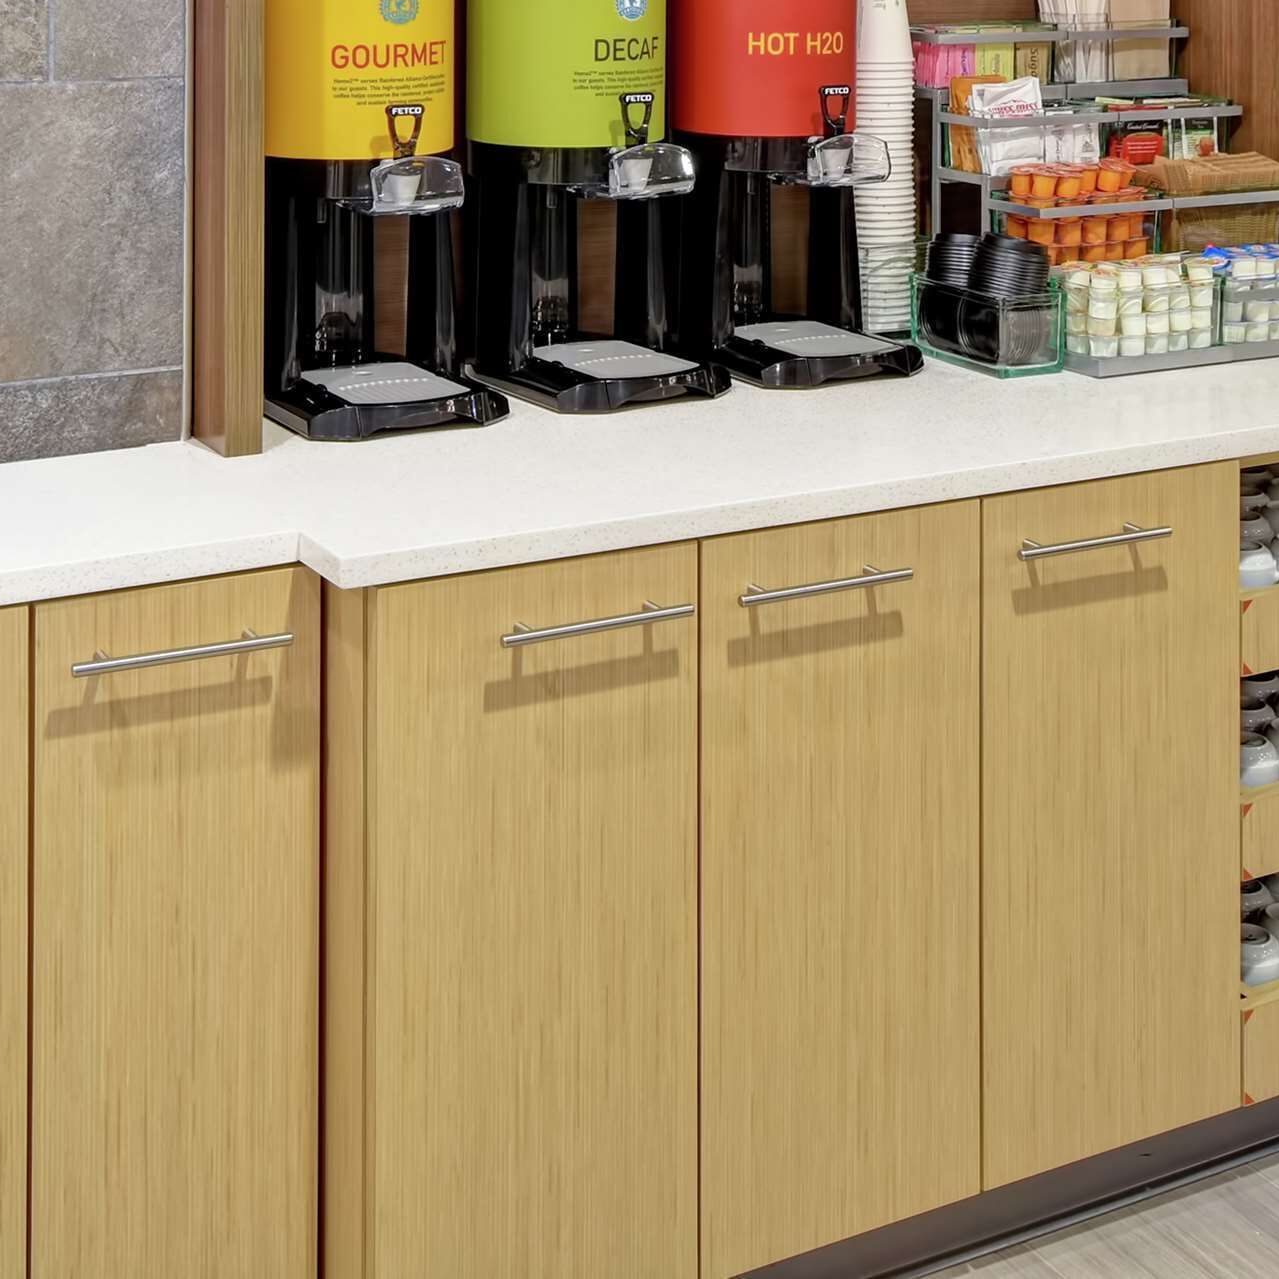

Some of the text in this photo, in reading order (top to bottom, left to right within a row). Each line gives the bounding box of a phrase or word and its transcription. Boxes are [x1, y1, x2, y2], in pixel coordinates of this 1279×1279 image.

[330, 39, 447, 70] GOURMET
[593, 36, 659, 62] DECAF
[747, 31, 800, 56] HOT
[1028, 47, 1039, 78] Suga
[625, 94, 652, 103] FETCO
[824, 86, 850, 95] FETCO
[391, 106, 422, 115] FETCO
